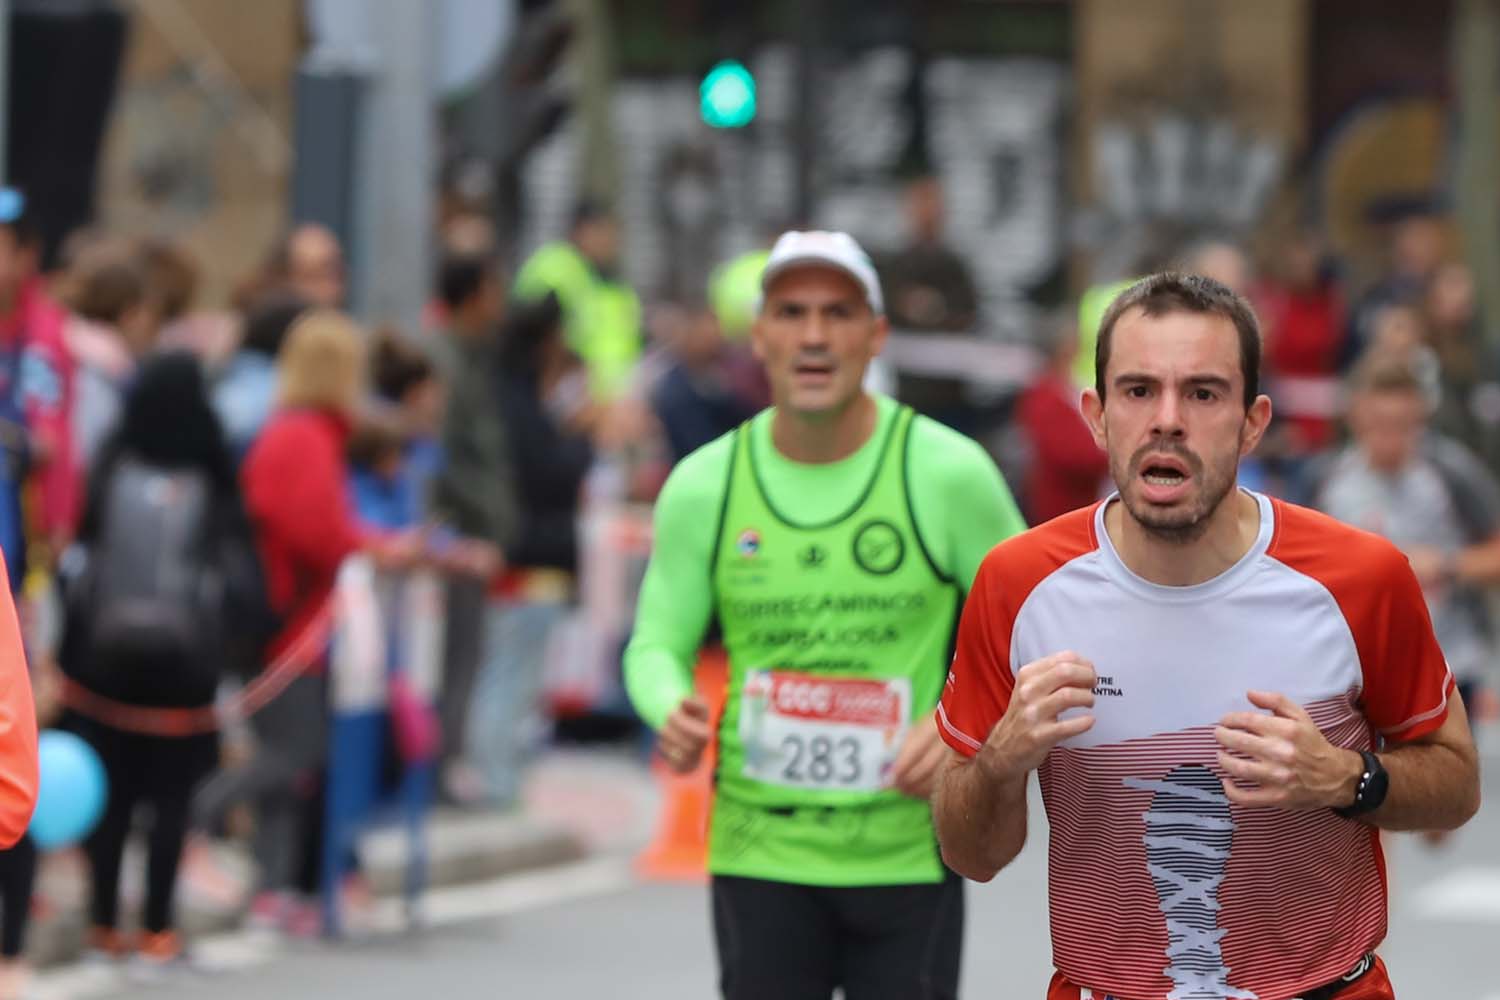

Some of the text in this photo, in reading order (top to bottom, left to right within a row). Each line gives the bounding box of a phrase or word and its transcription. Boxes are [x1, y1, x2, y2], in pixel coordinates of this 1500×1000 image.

[1096, 676, 1113, 686] TRE
[1091, 687, 1123, 697] ANTINA
[780, 734, 862, 784] 283
